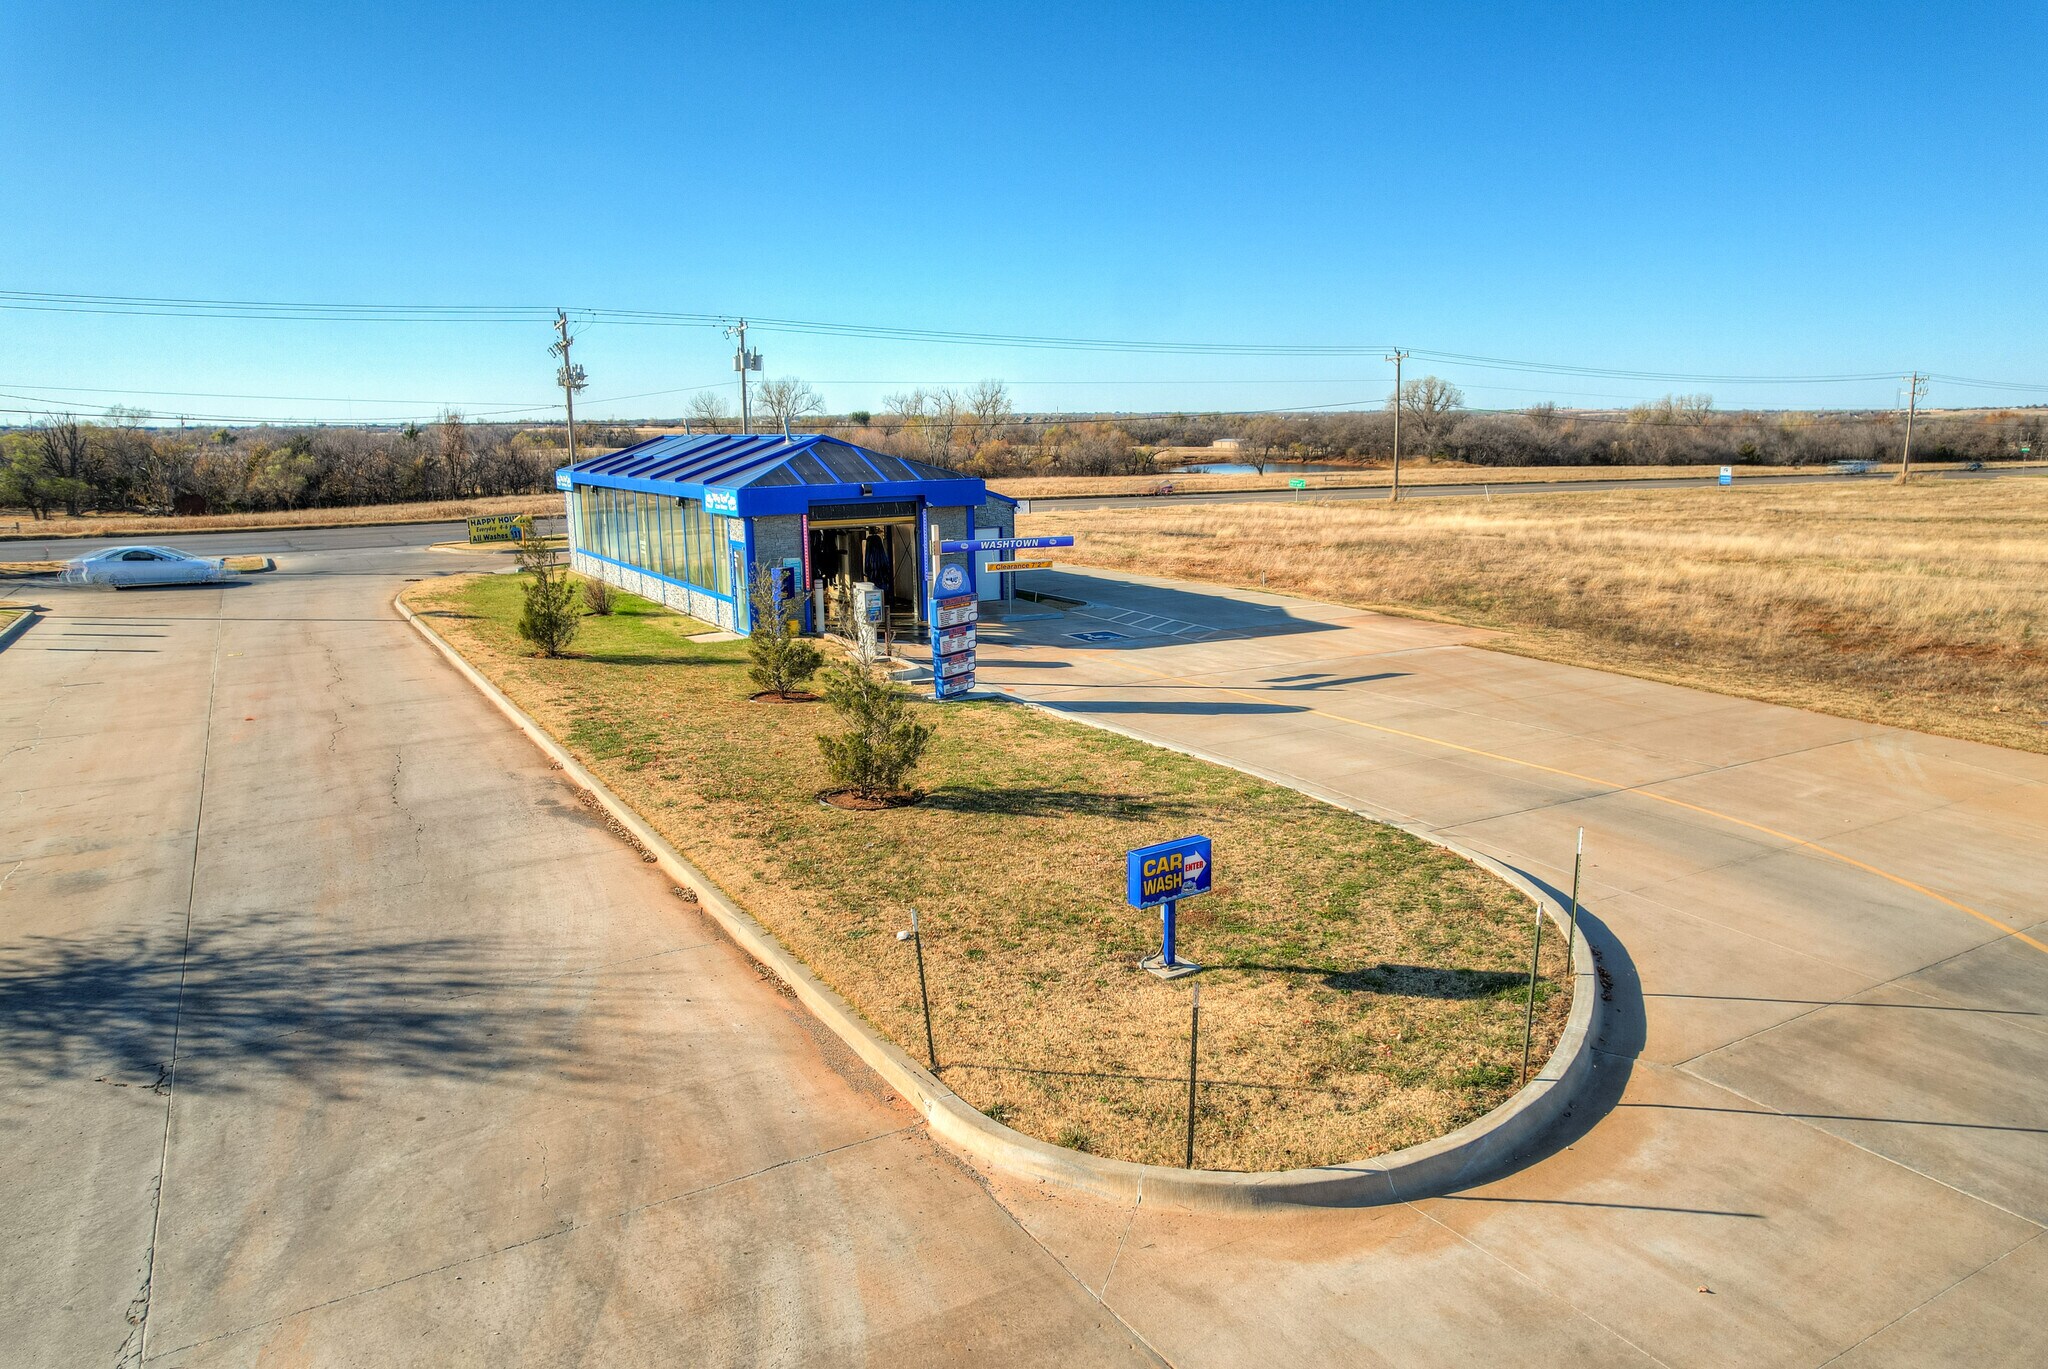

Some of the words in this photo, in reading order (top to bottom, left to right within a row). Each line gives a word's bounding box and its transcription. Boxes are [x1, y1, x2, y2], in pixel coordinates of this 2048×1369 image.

[470, 517, 496, 526] HAPPY
[484, 533, 508, 541] Washes
[980, 539, 1039, 549] WASHTOWN
[1143, 853, 1183, 877] CAR
[1185, 861, 1203, 872] ENTER
[1143, 872, 1183, 896] WASH
